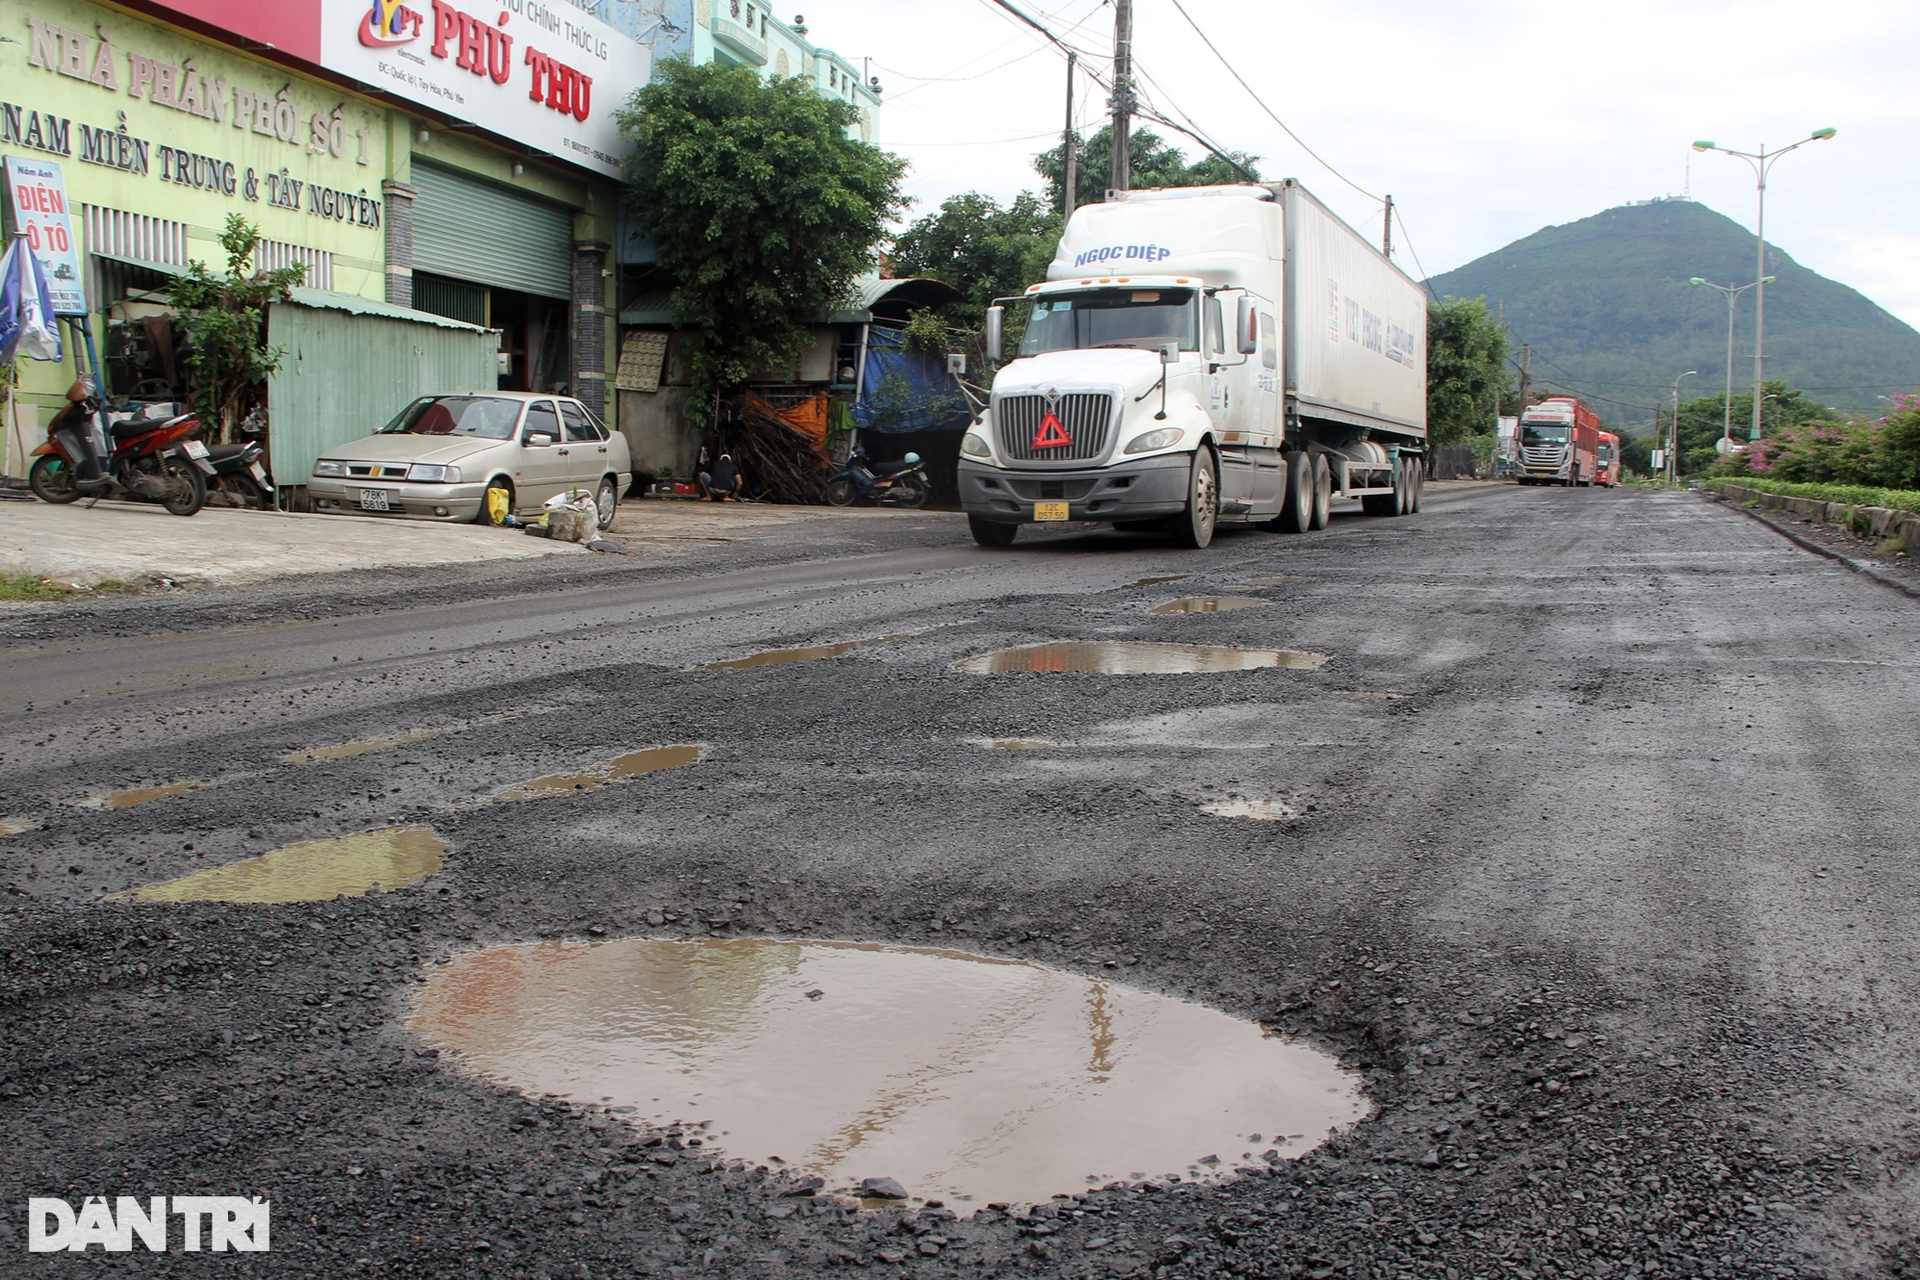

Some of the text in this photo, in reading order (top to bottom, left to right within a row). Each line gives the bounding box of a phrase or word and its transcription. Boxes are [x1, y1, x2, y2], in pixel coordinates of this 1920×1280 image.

[527, 1, 560, 36] CHÍNH
[564, 20, 592, 52] THỨC
[595, 38, 607, 60] LG
[397, 48, 425, 66] electronic
[431, 0, 593, 122] PHÚ THU
[27, 17, 371, 166] NHÀ PHÂN PHỐI SỐ 1
[419, 77, 429, 93] Tuy
[0, 102, 381, 230] NAM MIỀN TRUNG & TÂY NGUYÊN
[38, 168, 53, 179] Anh
[17, 182, 65, 218] ĐIỆN
[26, 219, 69, 252] Ô TÔ
[1074, 244, 1171, 268] NGỌC DIỆP
[363, 500, 386, 509] 5819
